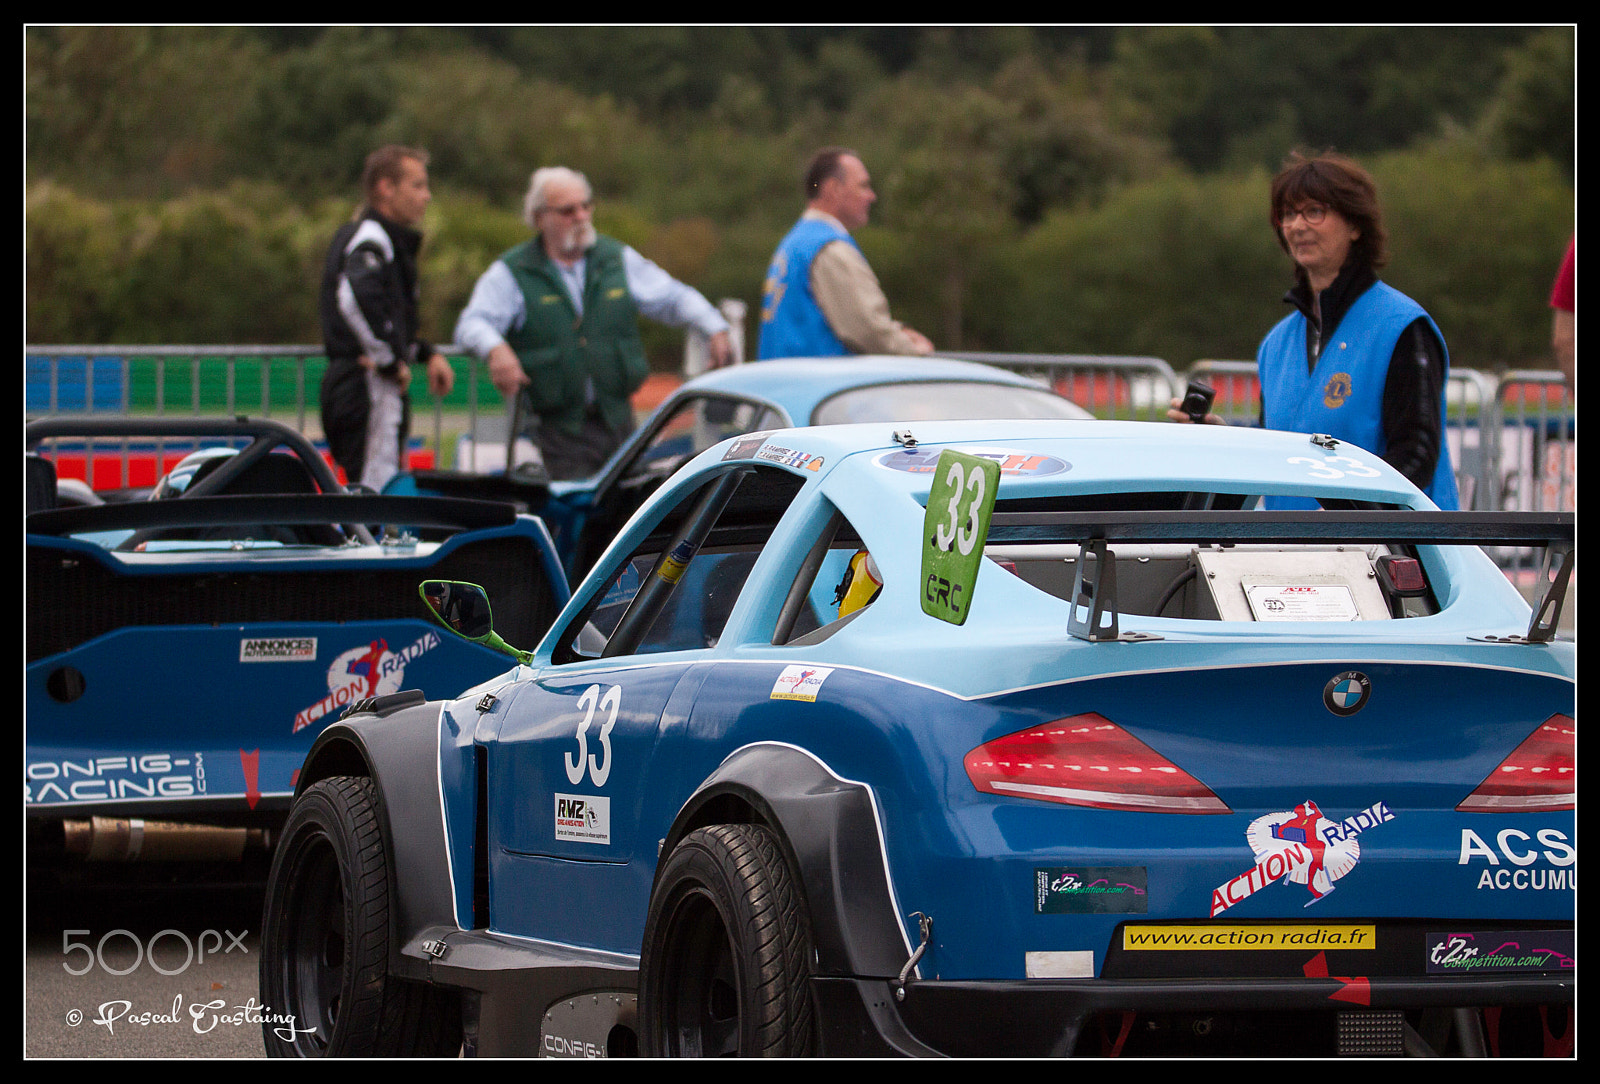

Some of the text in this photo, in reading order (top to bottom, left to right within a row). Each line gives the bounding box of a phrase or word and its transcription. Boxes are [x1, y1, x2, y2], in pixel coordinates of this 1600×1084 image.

[1286, 456, 1382, 479] 33
[937, 462, 985, 556] 33
[245, 640, 313, 650] ANNONCES
[1332, 672, 1369, 686] BMW
[292, 677, 364, 735] ACTION
[564, 683, 622, 788] 33
[558, 798, 585, 820] RMZ
[1209, 800, 1396, 919] ACTION RADIA
